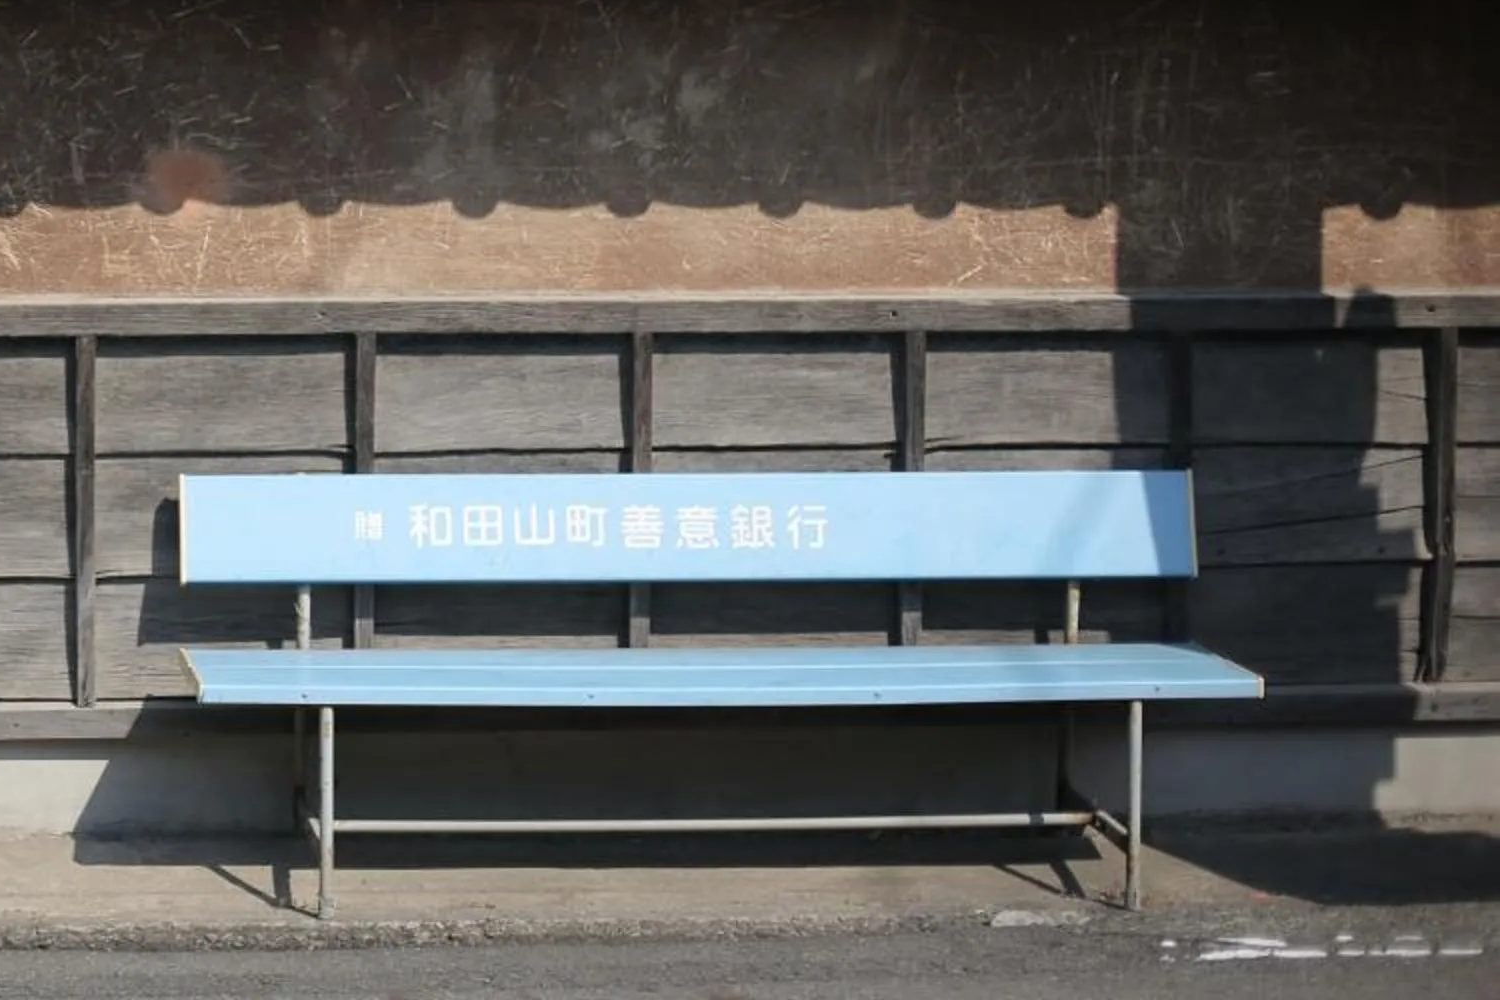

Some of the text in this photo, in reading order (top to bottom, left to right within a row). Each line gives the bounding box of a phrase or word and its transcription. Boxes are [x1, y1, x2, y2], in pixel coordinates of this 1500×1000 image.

[407, 503, 829, 550] 和田山町善意銀行
